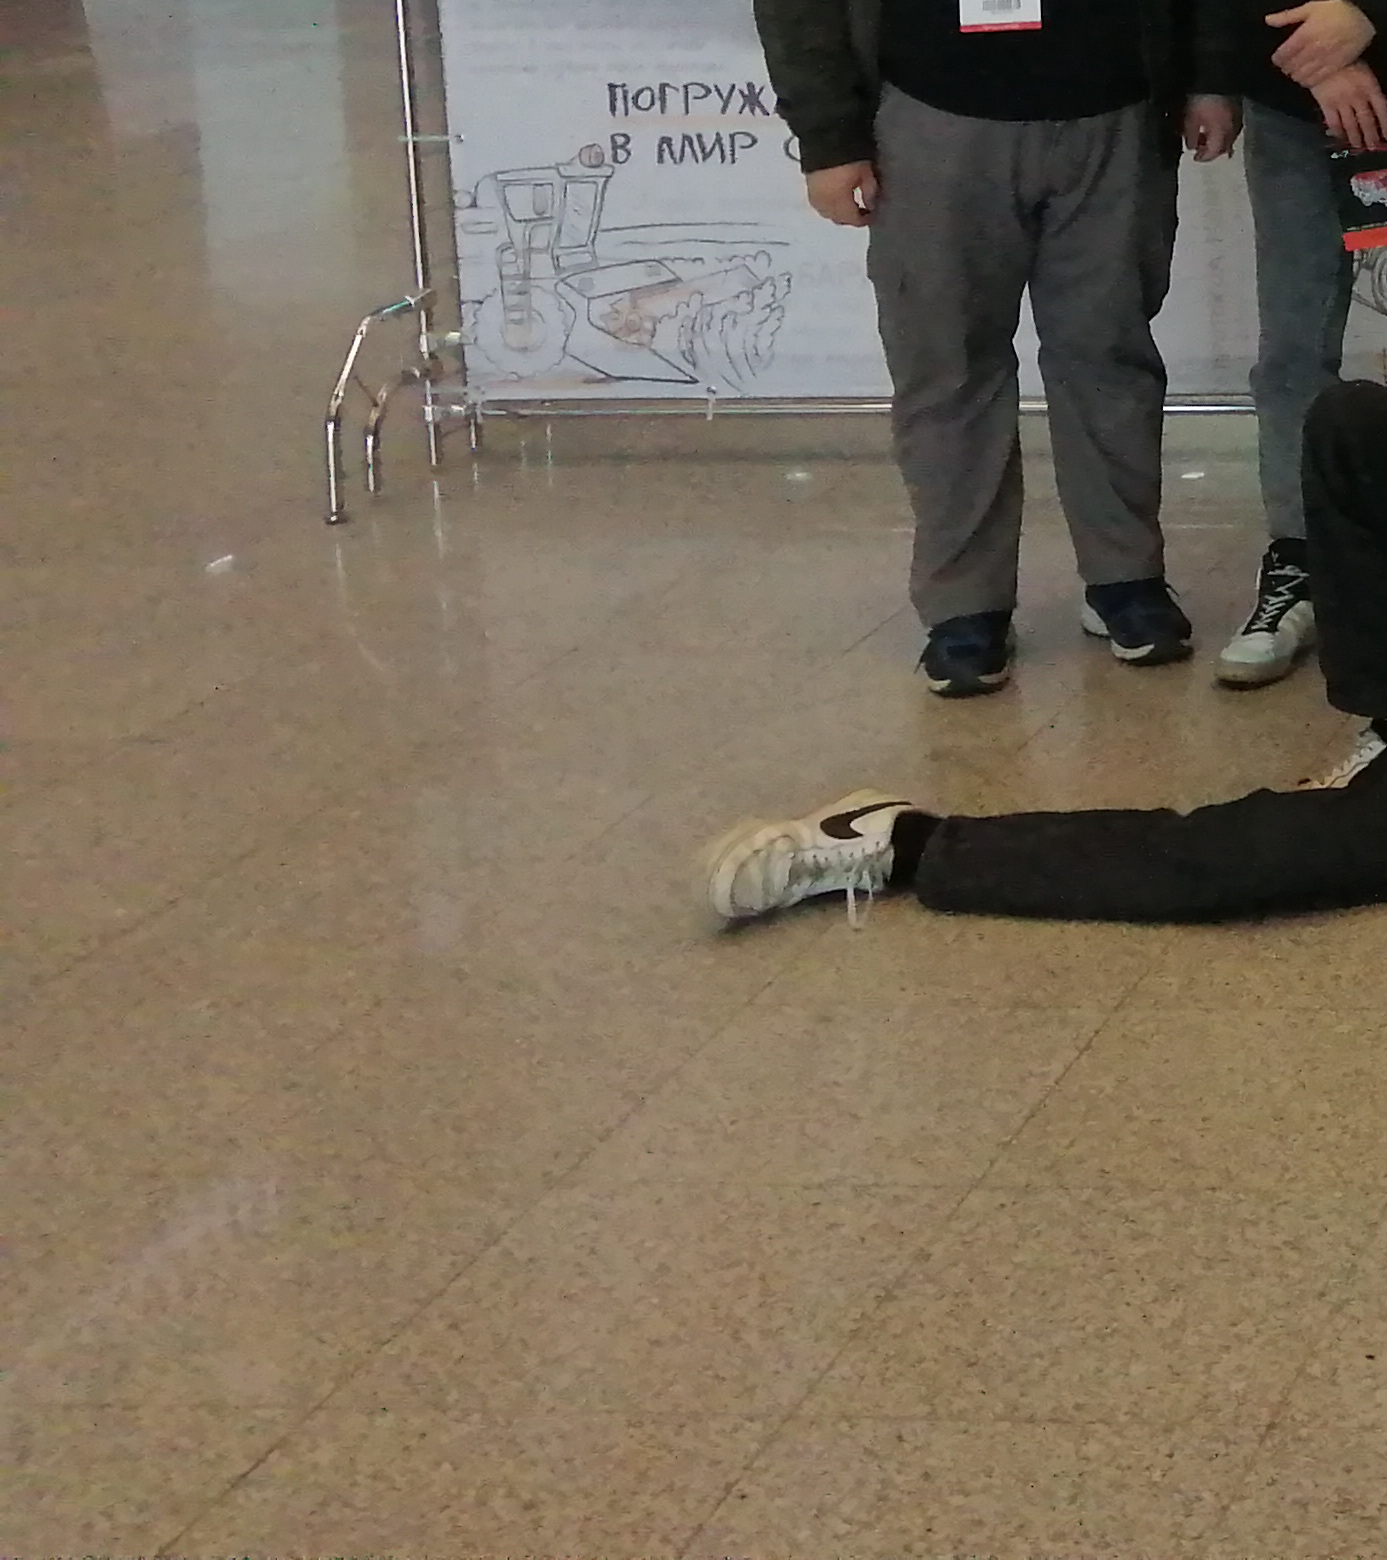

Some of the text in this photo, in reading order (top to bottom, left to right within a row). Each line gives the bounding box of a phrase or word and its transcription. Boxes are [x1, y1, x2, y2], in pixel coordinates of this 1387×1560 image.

[607, 82, 770, 118] ПОГРУЖ
[610, 132, 632, 165] В
[656, 132, 758, 165] МИР
